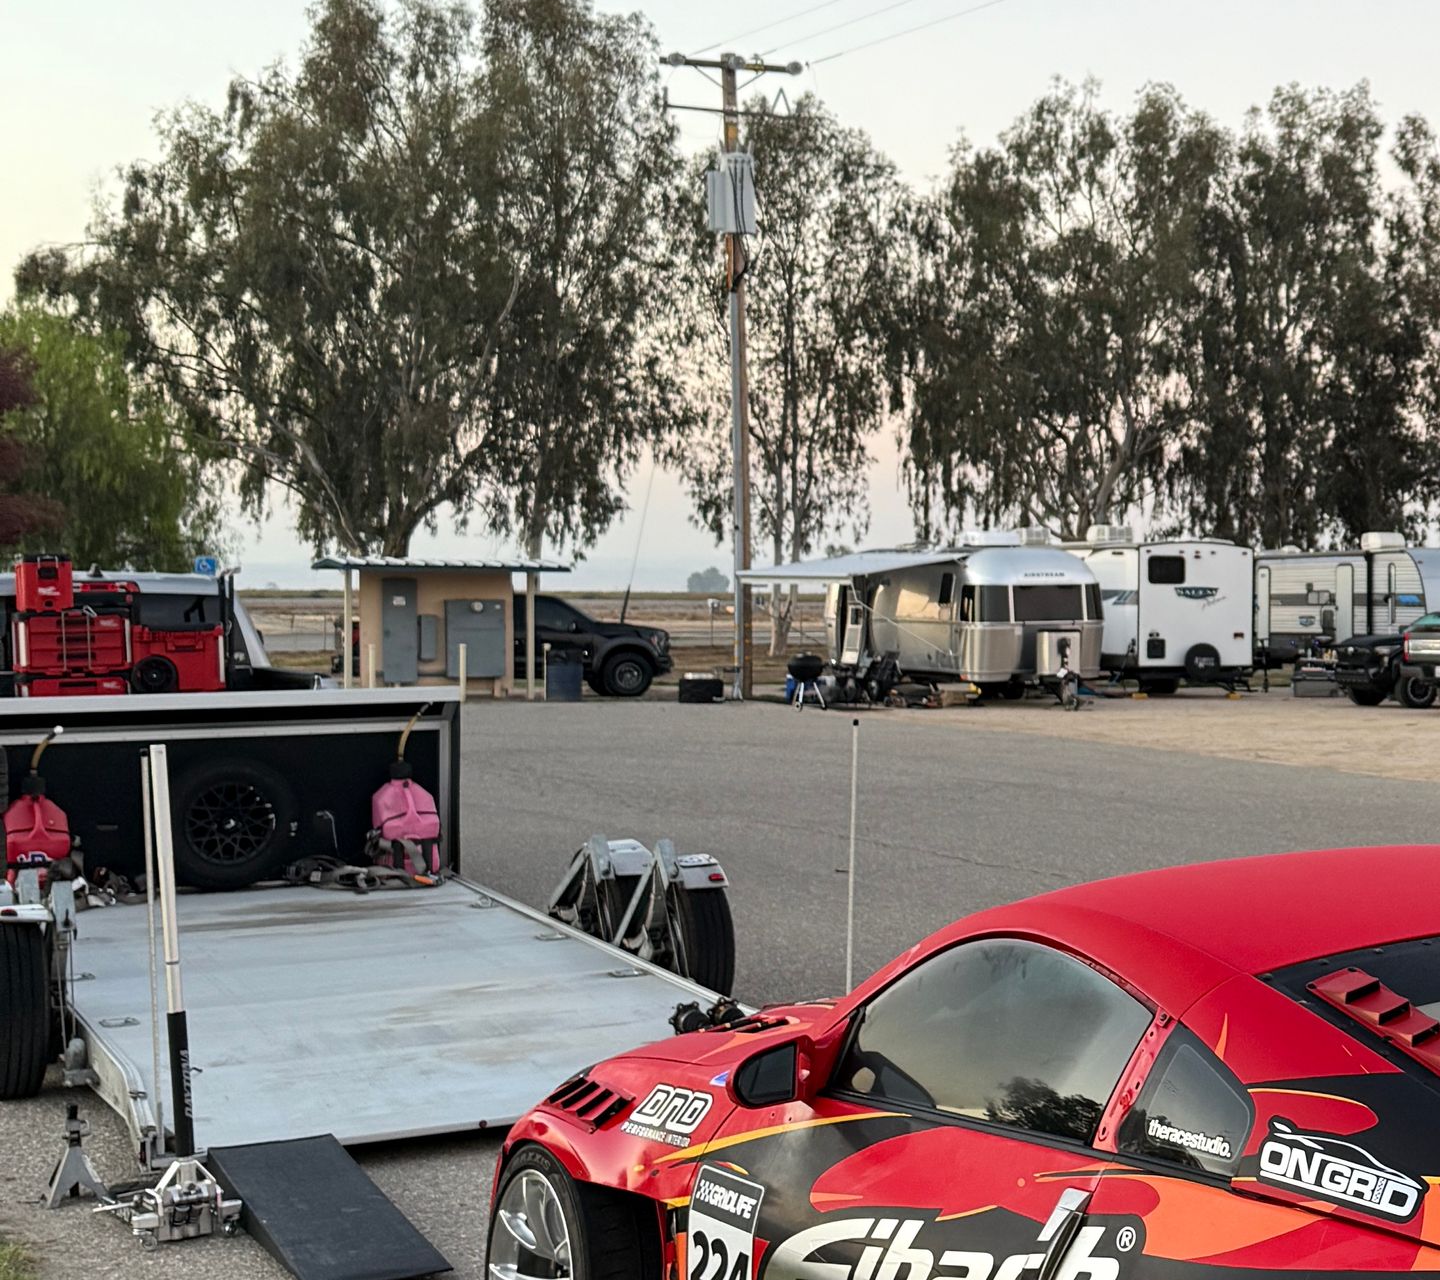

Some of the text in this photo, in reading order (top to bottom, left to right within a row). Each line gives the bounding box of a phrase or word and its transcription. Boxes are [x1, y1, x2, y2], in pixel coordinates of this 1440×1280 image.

[620, 1121, 691, 1148] PERFORMANCE INTERIOR
[1148, 1119, 1231, 1158] theracestudio.
[709, 1184, 758, 1219] GRIDLIFE
